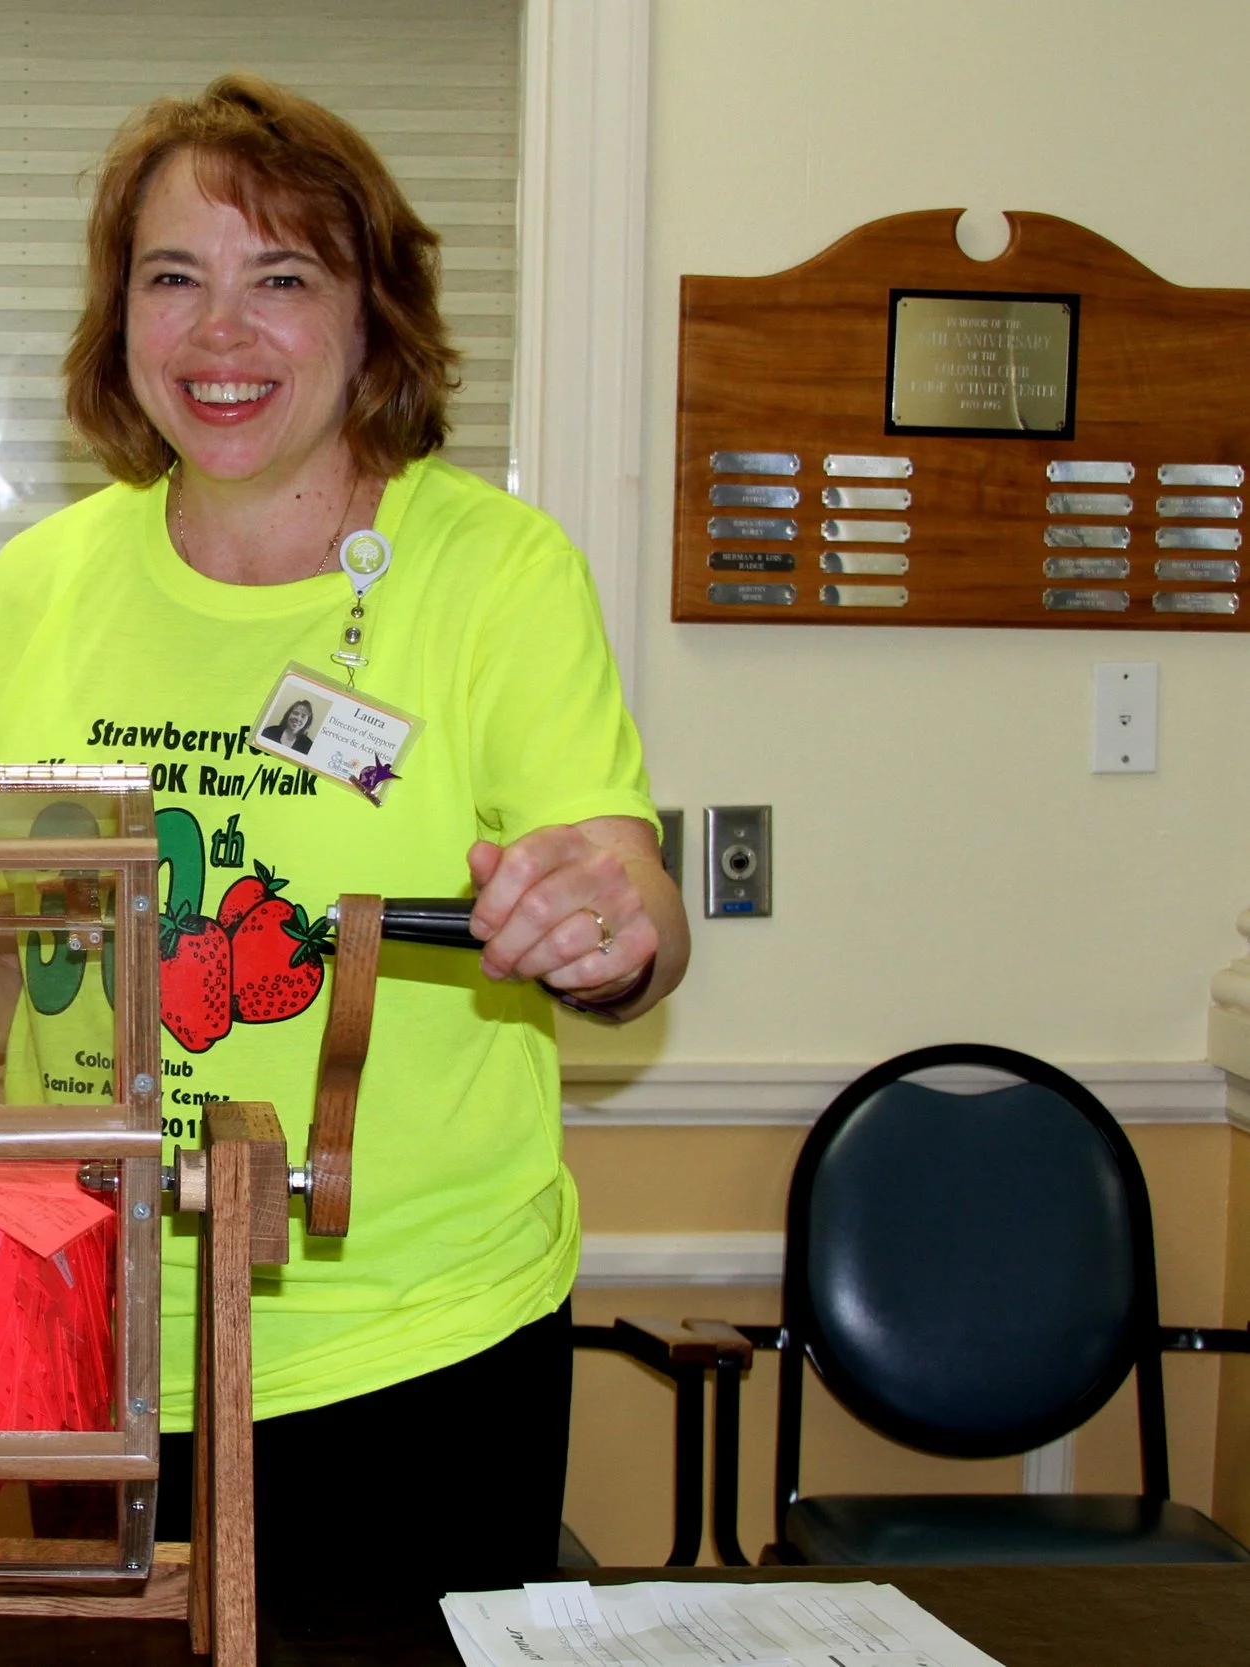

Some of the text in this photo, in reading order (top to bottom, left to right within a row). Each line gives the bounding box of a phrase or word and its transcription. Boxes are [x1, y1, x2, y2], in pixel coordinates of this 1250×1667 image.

[353, 707, 385, 730] Laura
[86, 718, 271, 761] StrawberryF
[320, 726, 349, 745] Services
[328, 716, 397, 751] Director of Support
[140, 762, 318, 800] 0K Run/Walk
[161, 1059, 193, 1078] lub
[43, 1074, 94, 1095] Senior
[161, 1117, 203, 1139] 201
